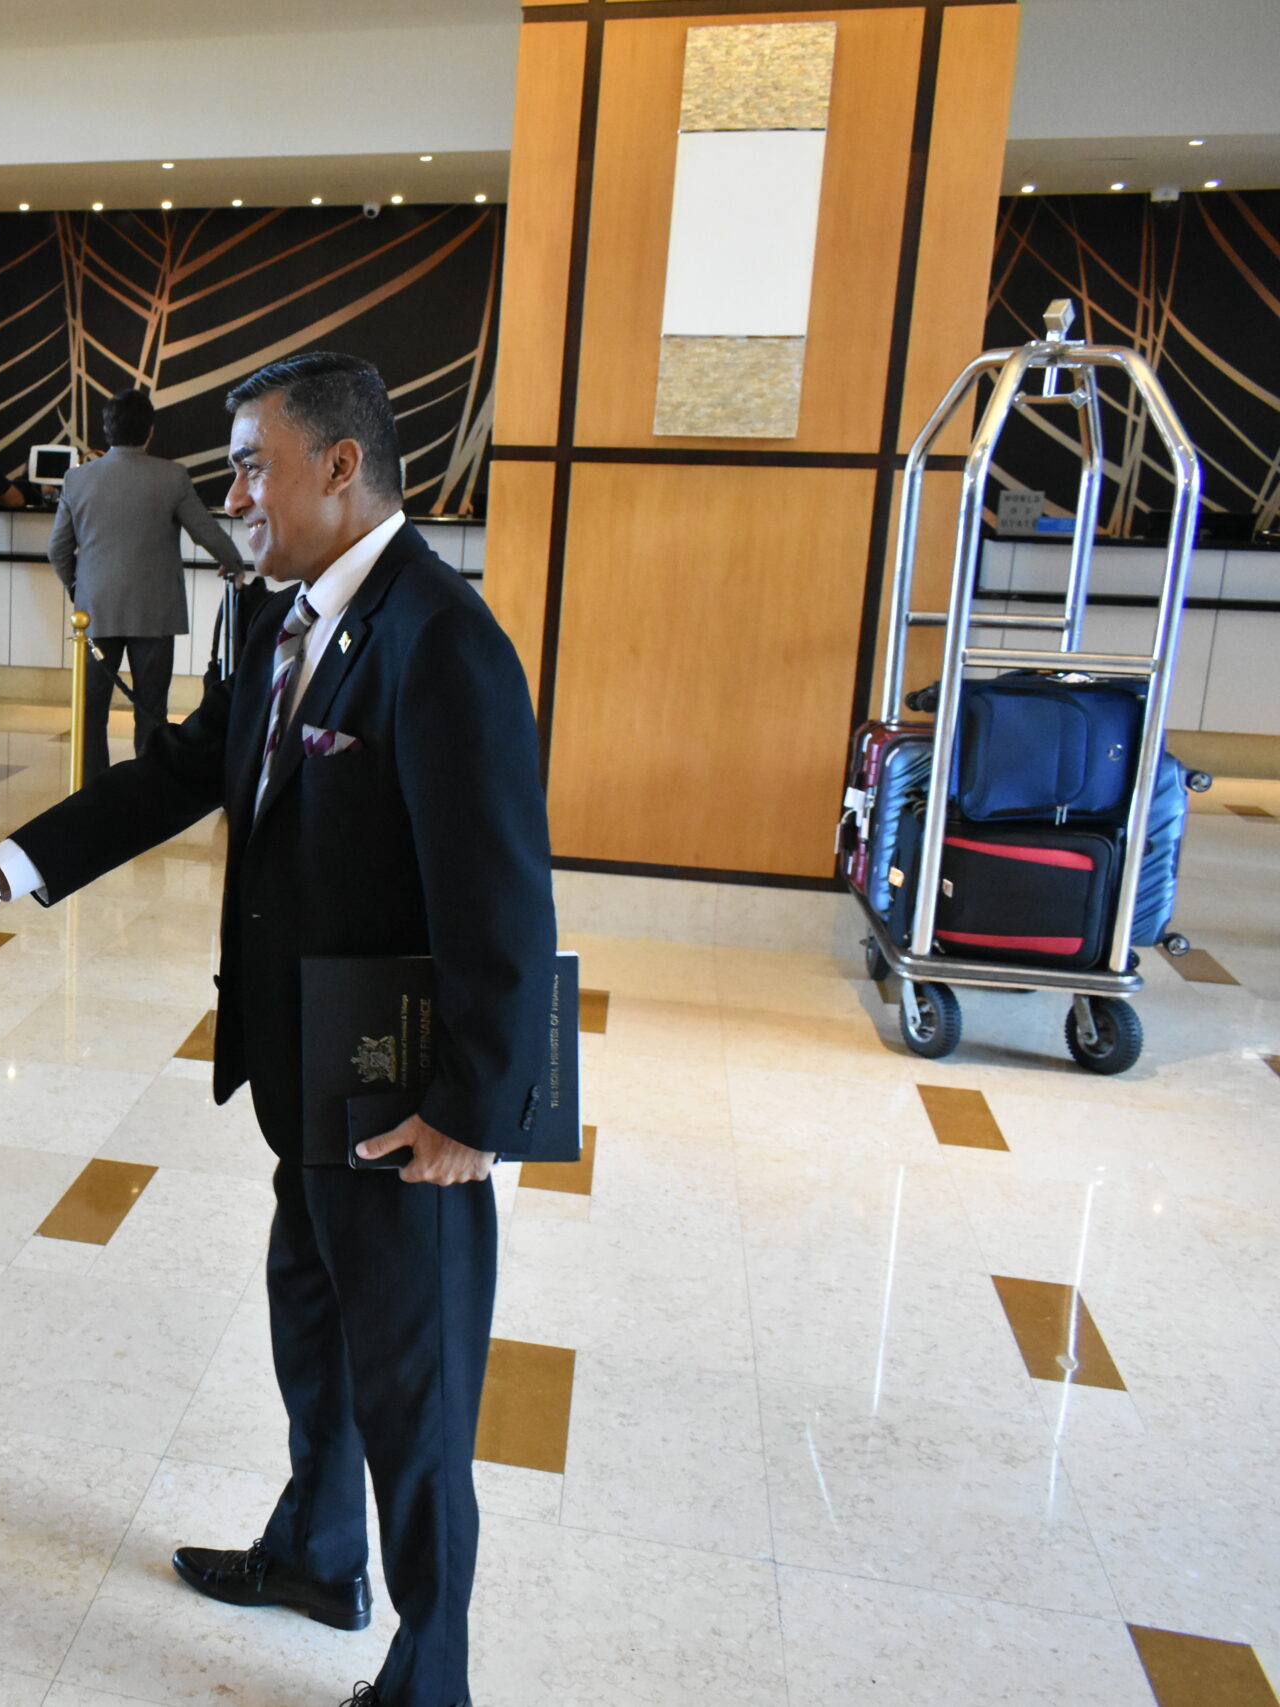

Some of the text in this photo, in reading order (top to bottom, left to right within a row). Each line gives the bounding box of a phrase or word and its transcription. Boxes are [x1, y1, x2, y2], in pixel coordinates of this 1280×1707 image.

[419, 998, 431, 1049] FINANCE
[550, 1013, 559, 1026] OF
[419, 1051, 431, 1069] OF
